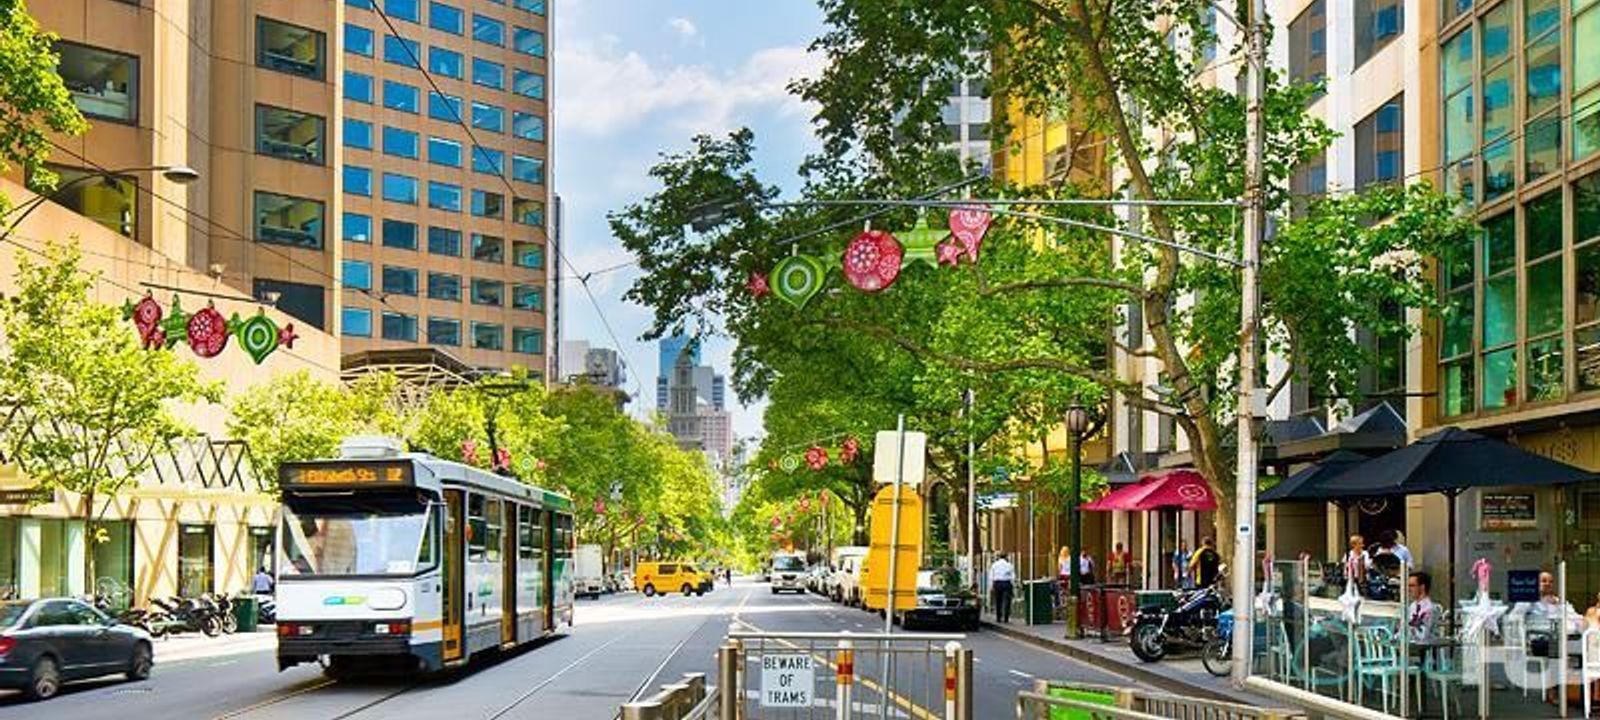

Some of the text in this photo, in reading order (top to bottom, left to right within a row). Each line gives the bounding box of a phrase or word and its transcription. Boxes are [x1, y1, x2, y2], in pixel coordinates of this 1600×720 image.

[764, 657, 810, 669] BEWARE
[780, 674, 794, 687] OF
[769, 691, 806, 703] TRAMS
